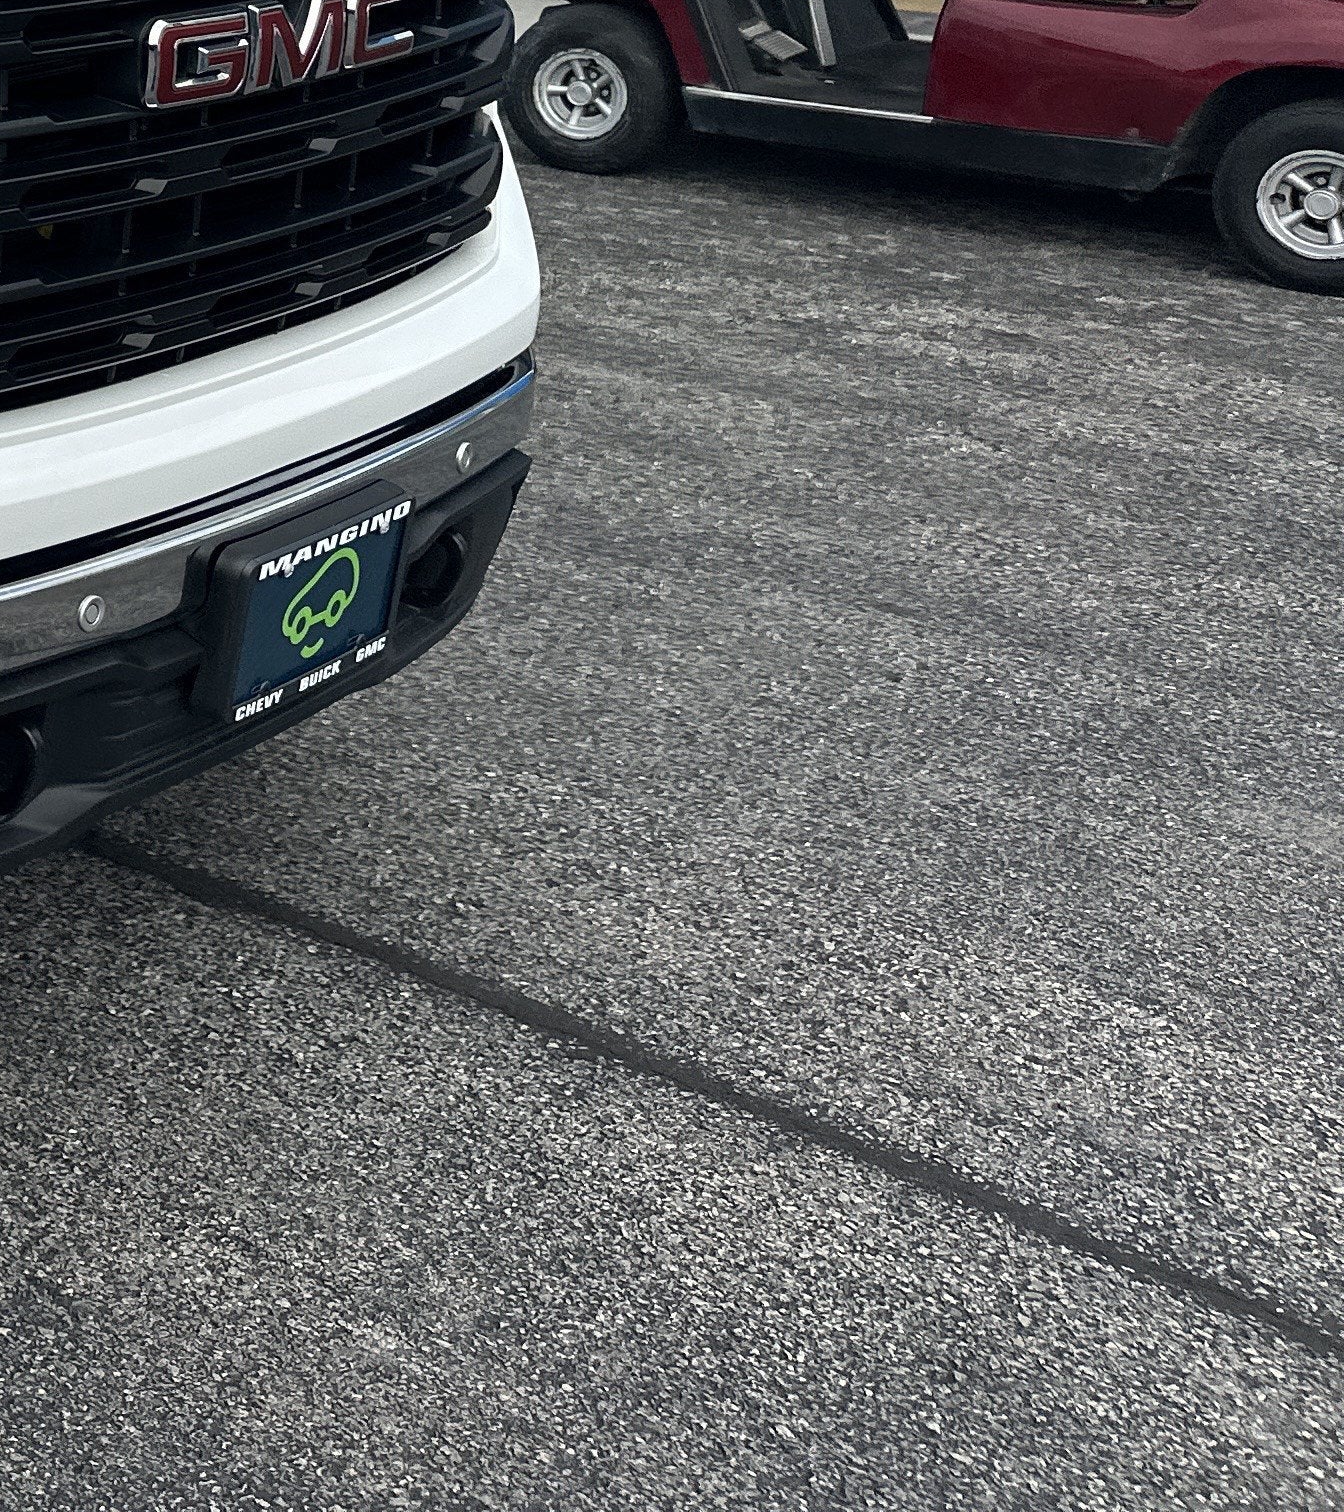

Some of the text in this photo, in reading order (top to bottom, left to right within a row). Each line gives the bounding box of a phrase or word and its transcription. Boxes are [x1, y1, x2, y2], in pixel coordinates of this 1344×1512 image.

[258, 500, 412, 581] MANGINO
[234, 637, 387, 722] CHEVY BUICK GMC
